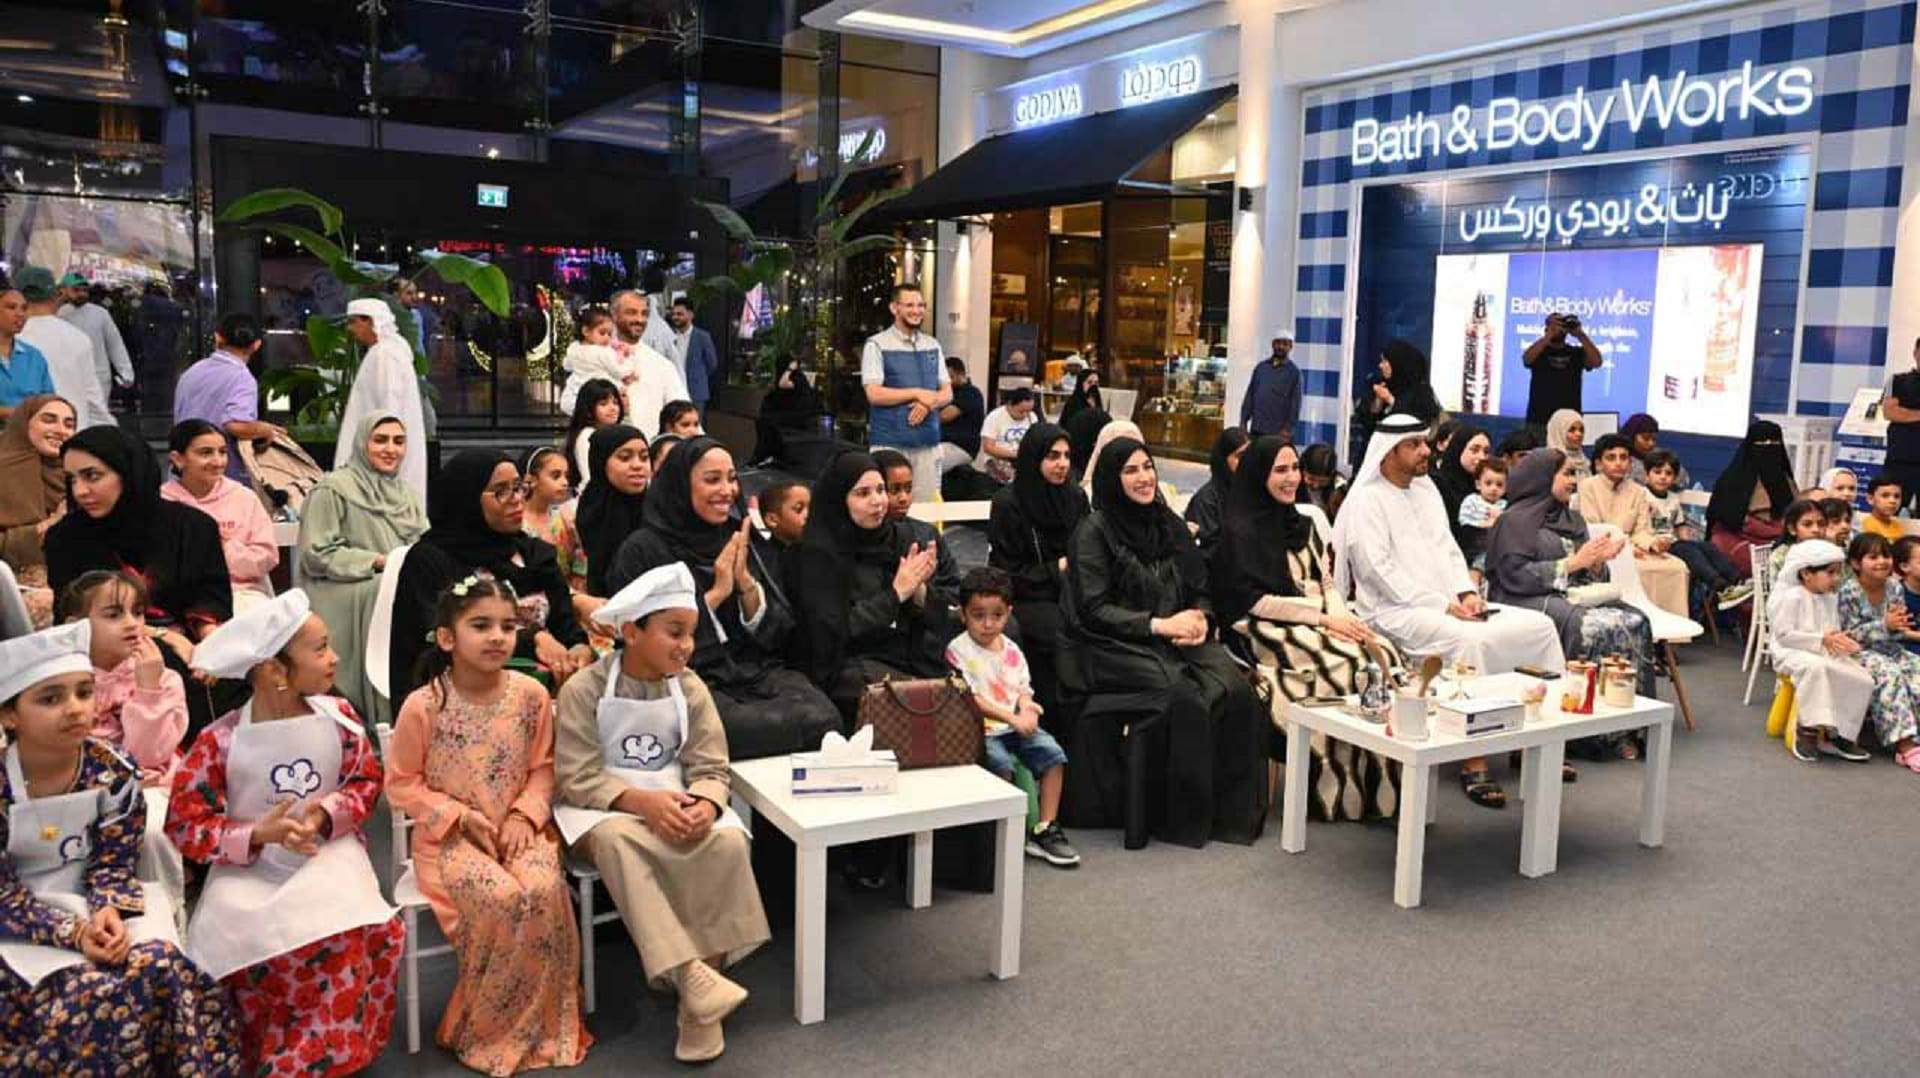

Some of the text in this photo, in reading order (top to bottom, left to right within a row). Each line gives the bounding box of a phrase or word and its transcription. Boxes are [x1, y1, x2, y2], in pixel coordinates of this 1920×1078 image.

[1015, 85, 1082, 125] GODIVA
[1351, 60, 1813, 167] Bath & Body Works
[1460, 182, 1729, 246] باث & بودي وركس
